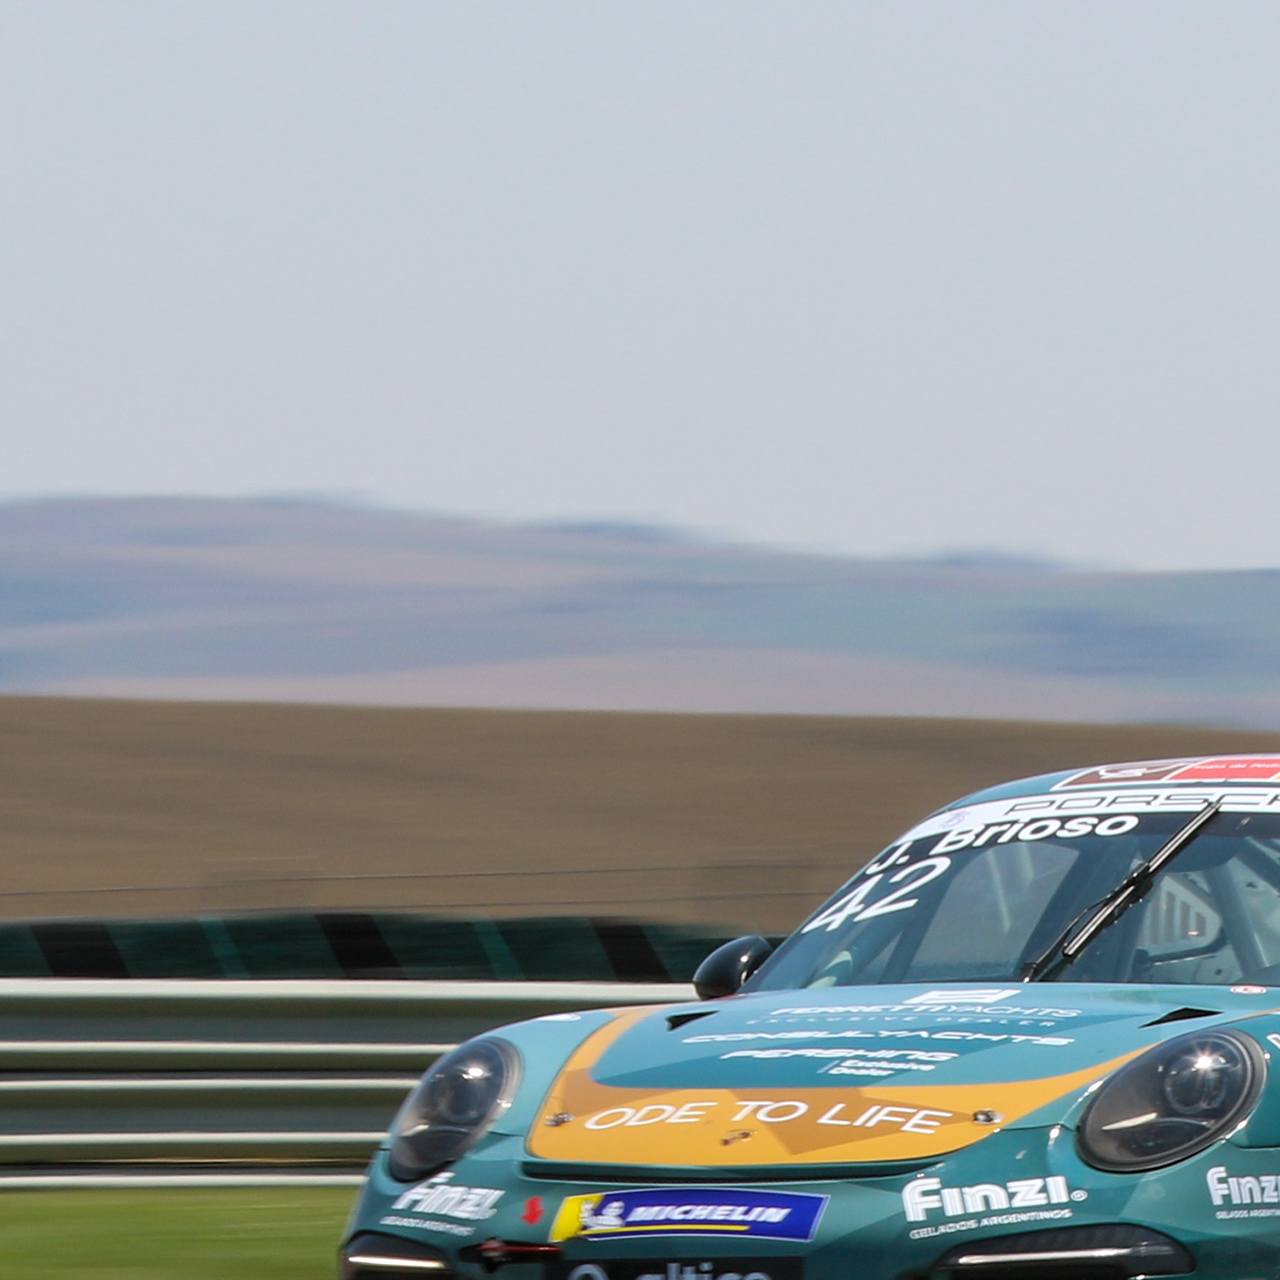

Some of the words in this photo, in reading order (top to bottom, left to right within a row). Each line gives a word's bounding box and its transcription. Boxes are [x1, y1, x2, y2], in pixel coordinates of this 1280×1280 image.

[865, 839, 911, 877] J.
[929, 814, 1140, 855] Brioso
[802, 855, 953, 936] 42
[681, 1030, 1077, 1047] CONSULYACHTS
[839, 1058, 936, 1072] Exclusive
[584, 1102, 718, 1131] ODE
[735, 1101, 809, 1125] TO
[816, 1103, 953, 1135] LIFE
[624, 1204, 792, 1224] MICHELIN
[908, 1218, 979, 1240] GELADOS
[979, 1208, 1074, 1227] ARGENTINOS
